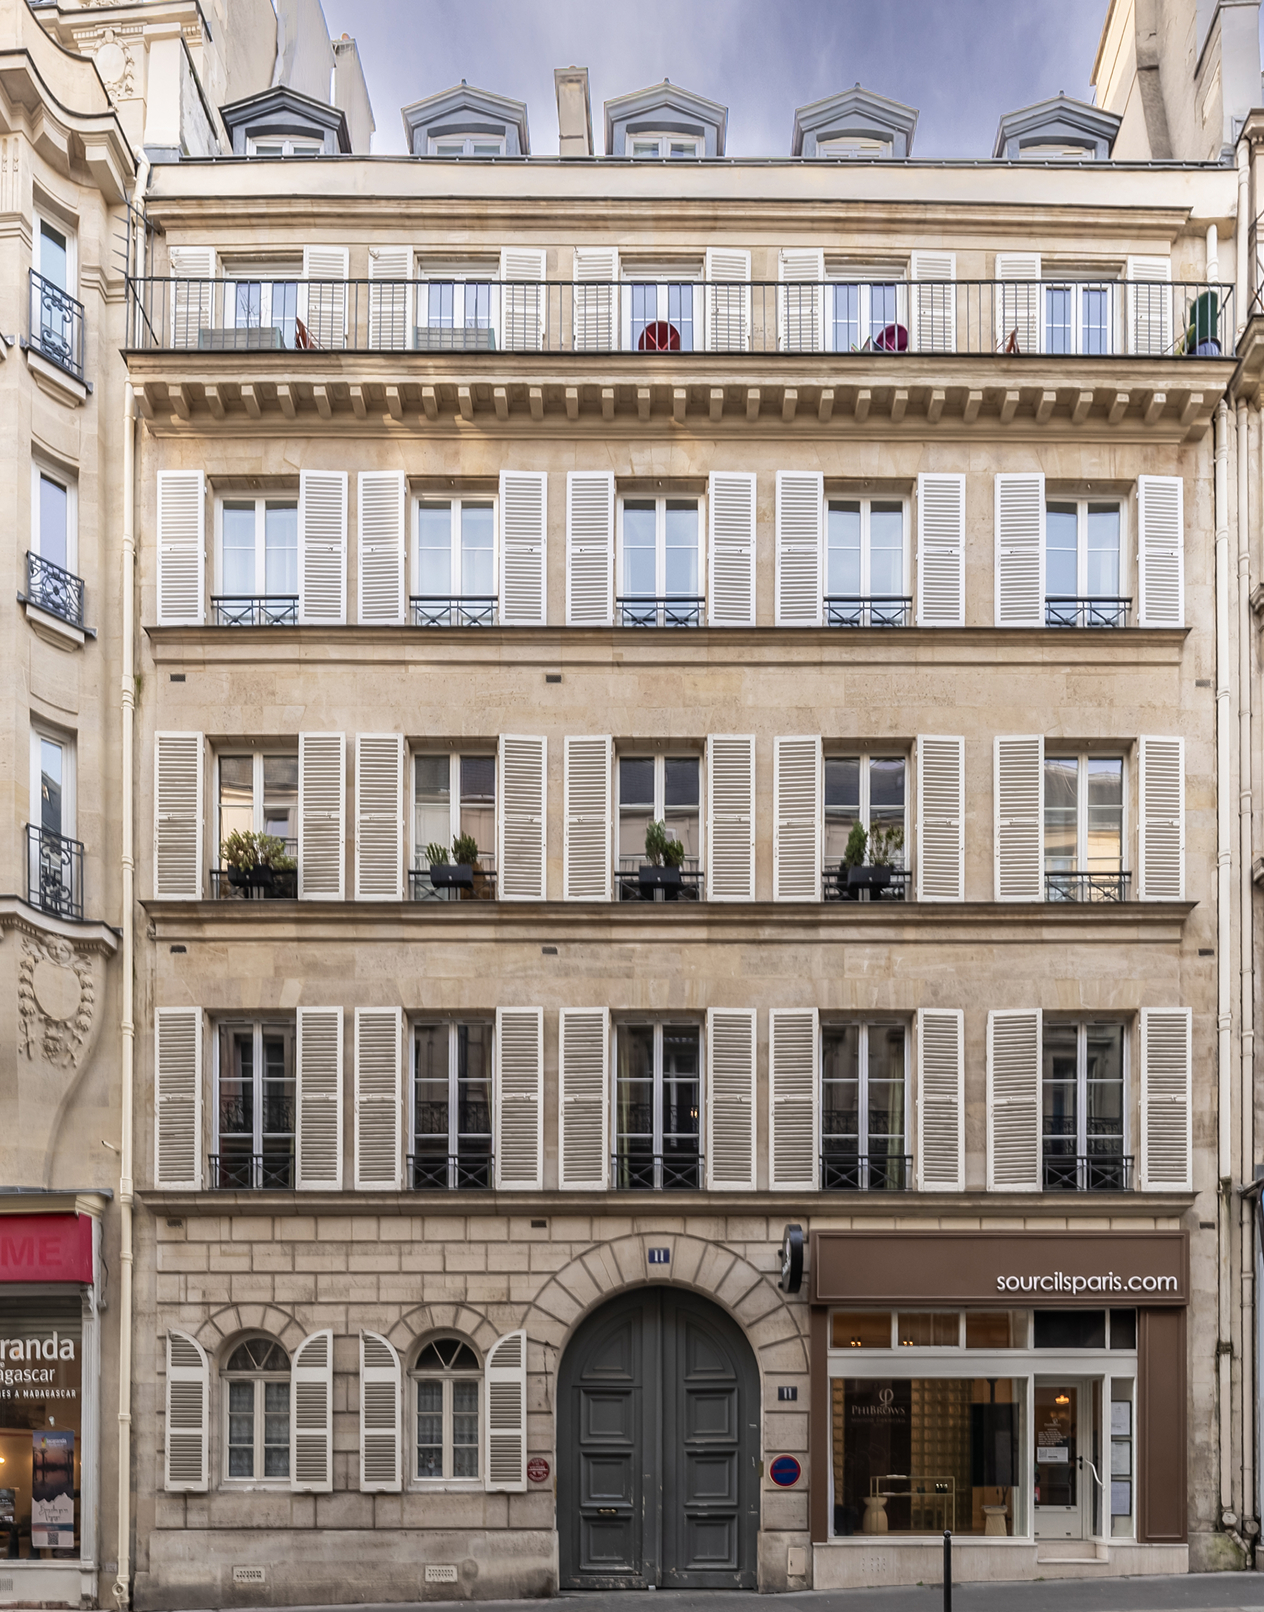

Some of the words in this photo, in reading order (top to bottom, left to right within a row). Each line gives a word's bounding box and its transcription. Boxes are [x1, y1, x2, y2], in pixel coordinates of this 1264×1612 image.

[1, 1236, 62, 1266] ME
[654, 1249, 664, 1262] 11
[997, 1271, 1178, 1295] sourcilsparis.com
[0, 1331, 75, 1361] randa
[0, 1389, 11, 1399] ES
[23, 1389, 77, 1399] MADAGASCAR
